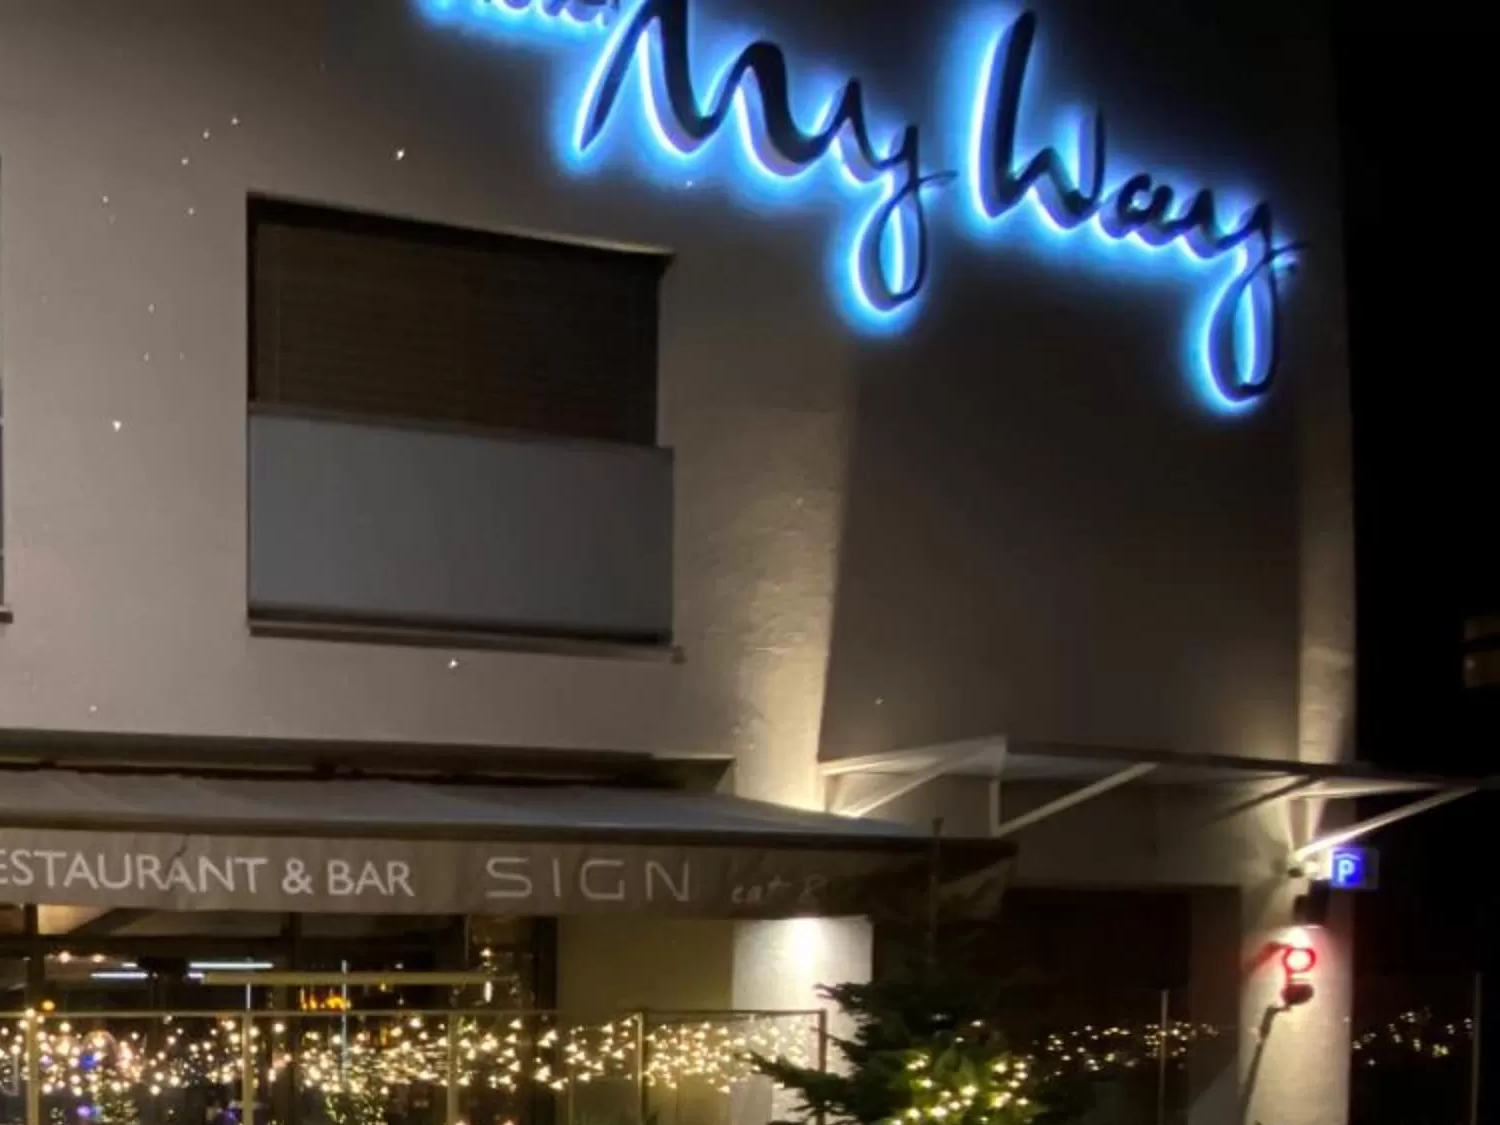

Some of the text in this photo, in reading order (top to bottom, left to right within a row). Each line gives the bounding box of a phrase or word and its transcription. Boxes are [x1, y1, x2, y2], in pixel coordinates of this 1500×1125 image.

[576, 0, 1308, 404] My Way
[280, 859, 313, 895] &
[327, 860, 416, 897] BAR
[484, 856, 689, 902] SIGN
[730, 873, 793, 905] eat
